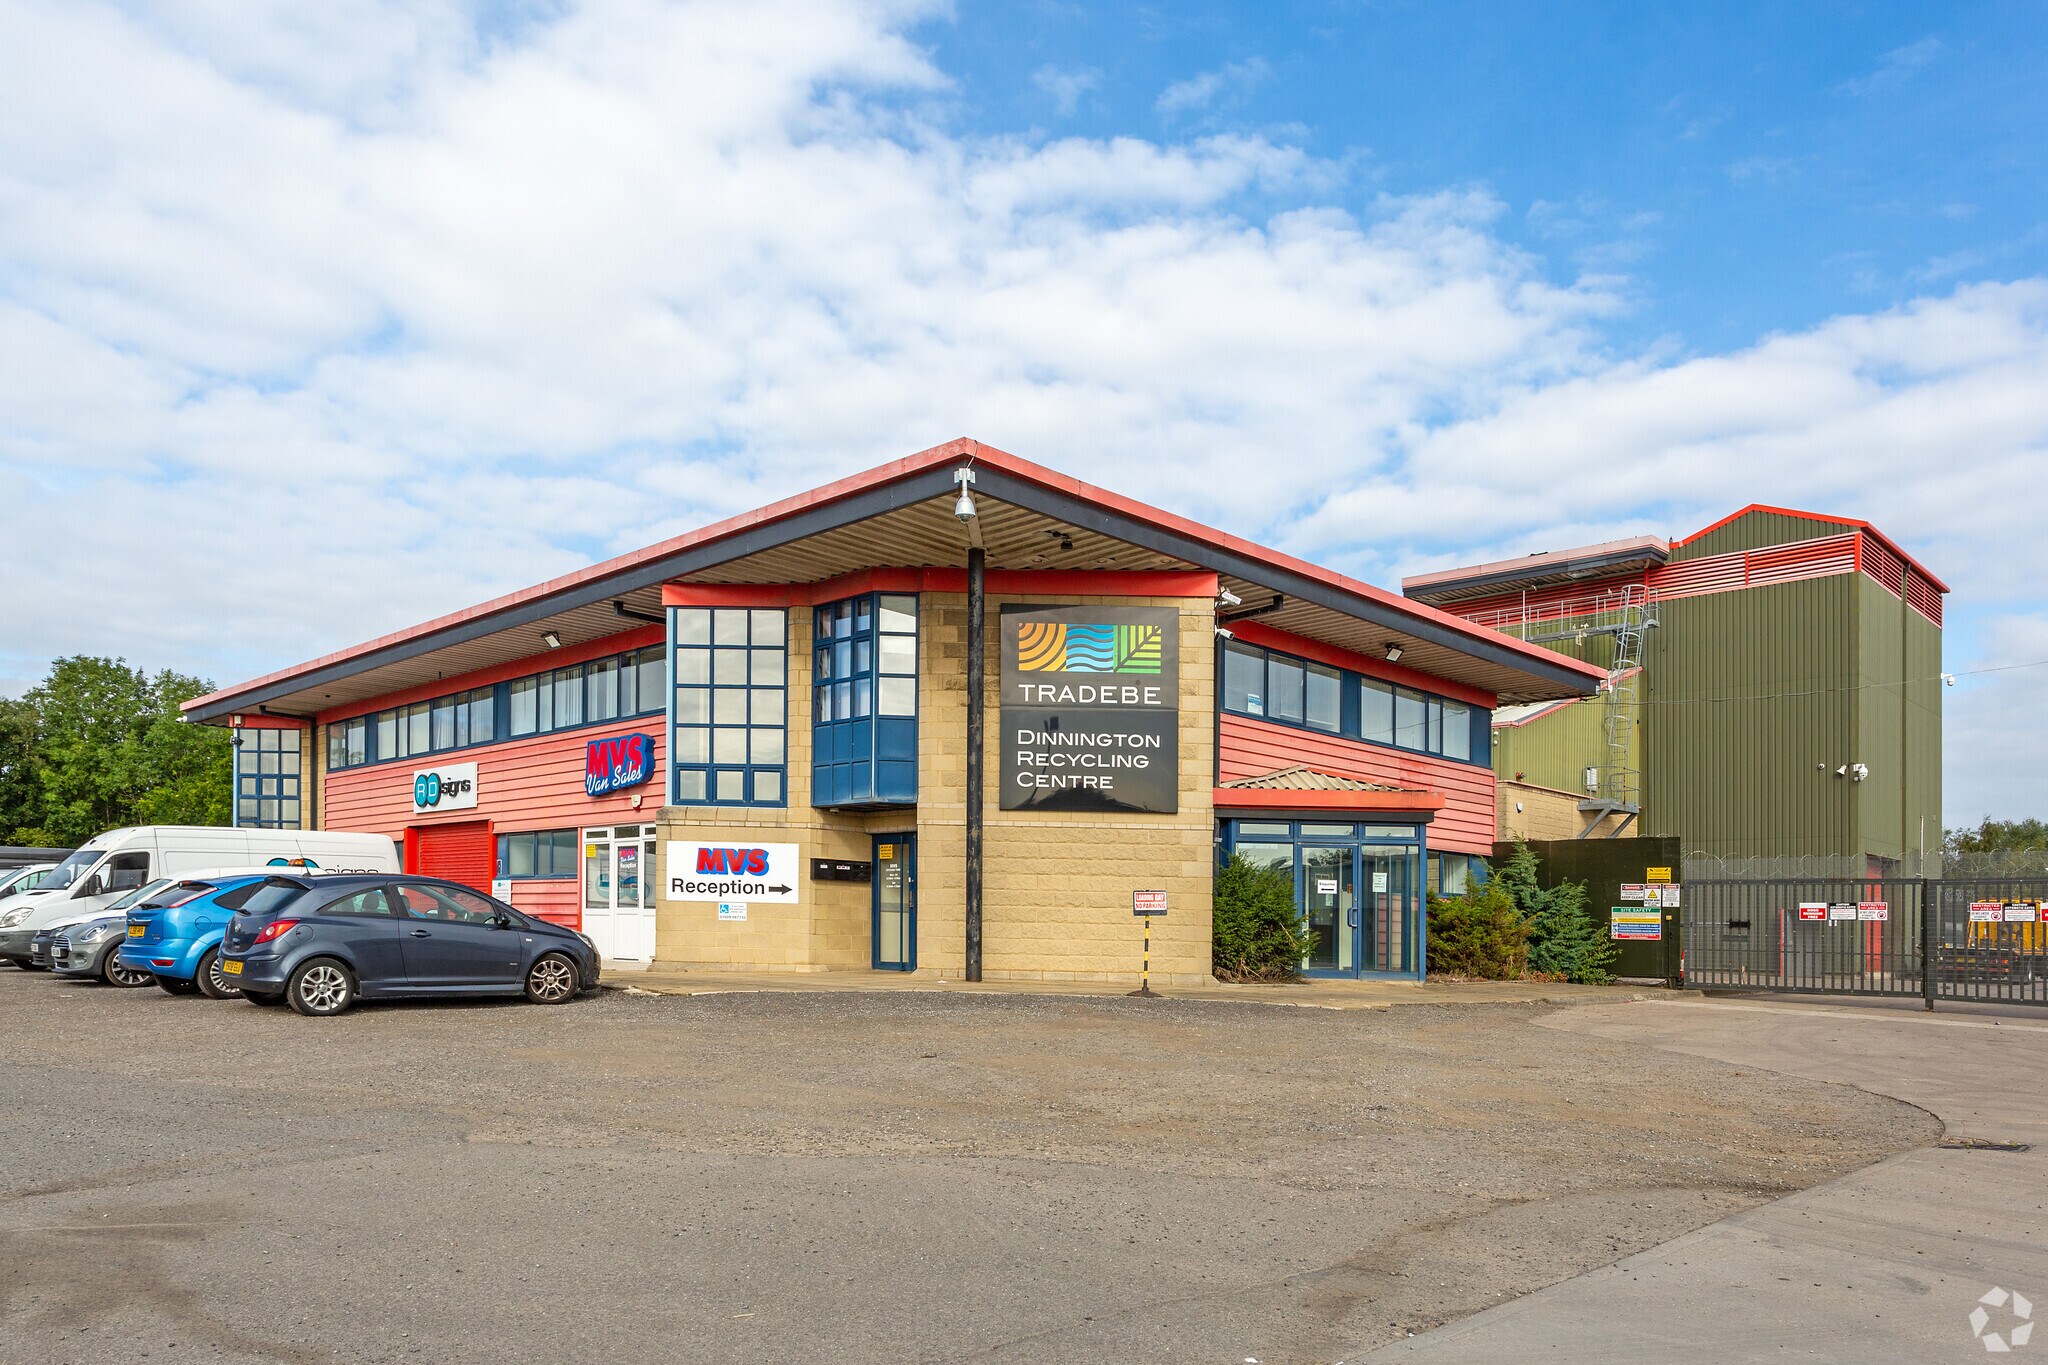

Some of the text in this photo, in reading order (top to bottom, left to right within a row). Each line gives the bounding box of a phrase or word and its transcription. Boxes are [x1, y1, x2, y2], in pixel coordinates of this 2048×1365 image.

[1018, 684, 1162, 705] TRADEBE
[1017, 729, 1161, 748] DINNINGTON
[588, 736, 642, 778] MVS
[1017, 751, 1150, 769] RECYCLING
[586, 761, 643, 794] Van Sales
[1016, 772, 1114, 789] CENTRE
[696, 847, 769, 876] MVS
[671, 878, 765, 897] Reception
[1136, 893, 1165, 901] LOADING BAY
